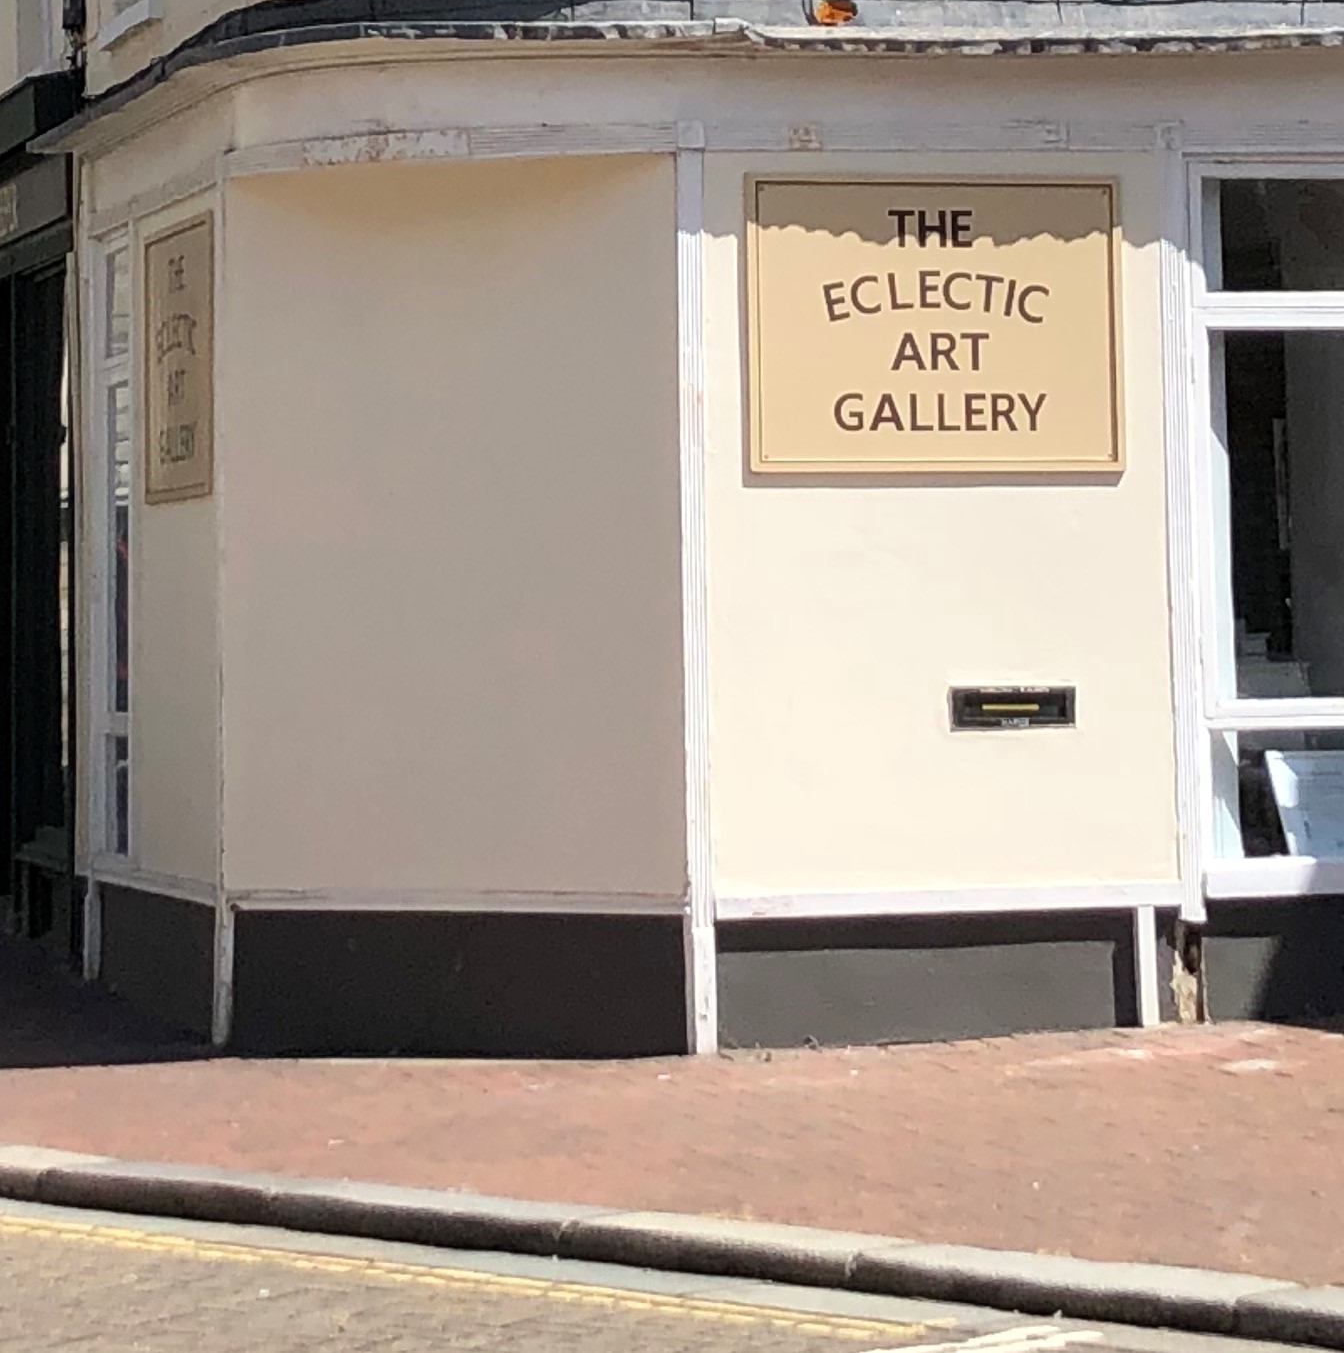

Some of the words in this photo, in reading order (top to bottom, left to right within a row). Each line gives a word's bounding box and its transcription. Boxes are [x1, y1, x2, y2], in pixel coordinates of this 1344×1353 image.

[887, 209, 973, 248] THE
[822, 269, 1051, 324] ECLECTIC
[890, 331, 990, 372] ART
[833, 392, 1048, 432] GALLERY
